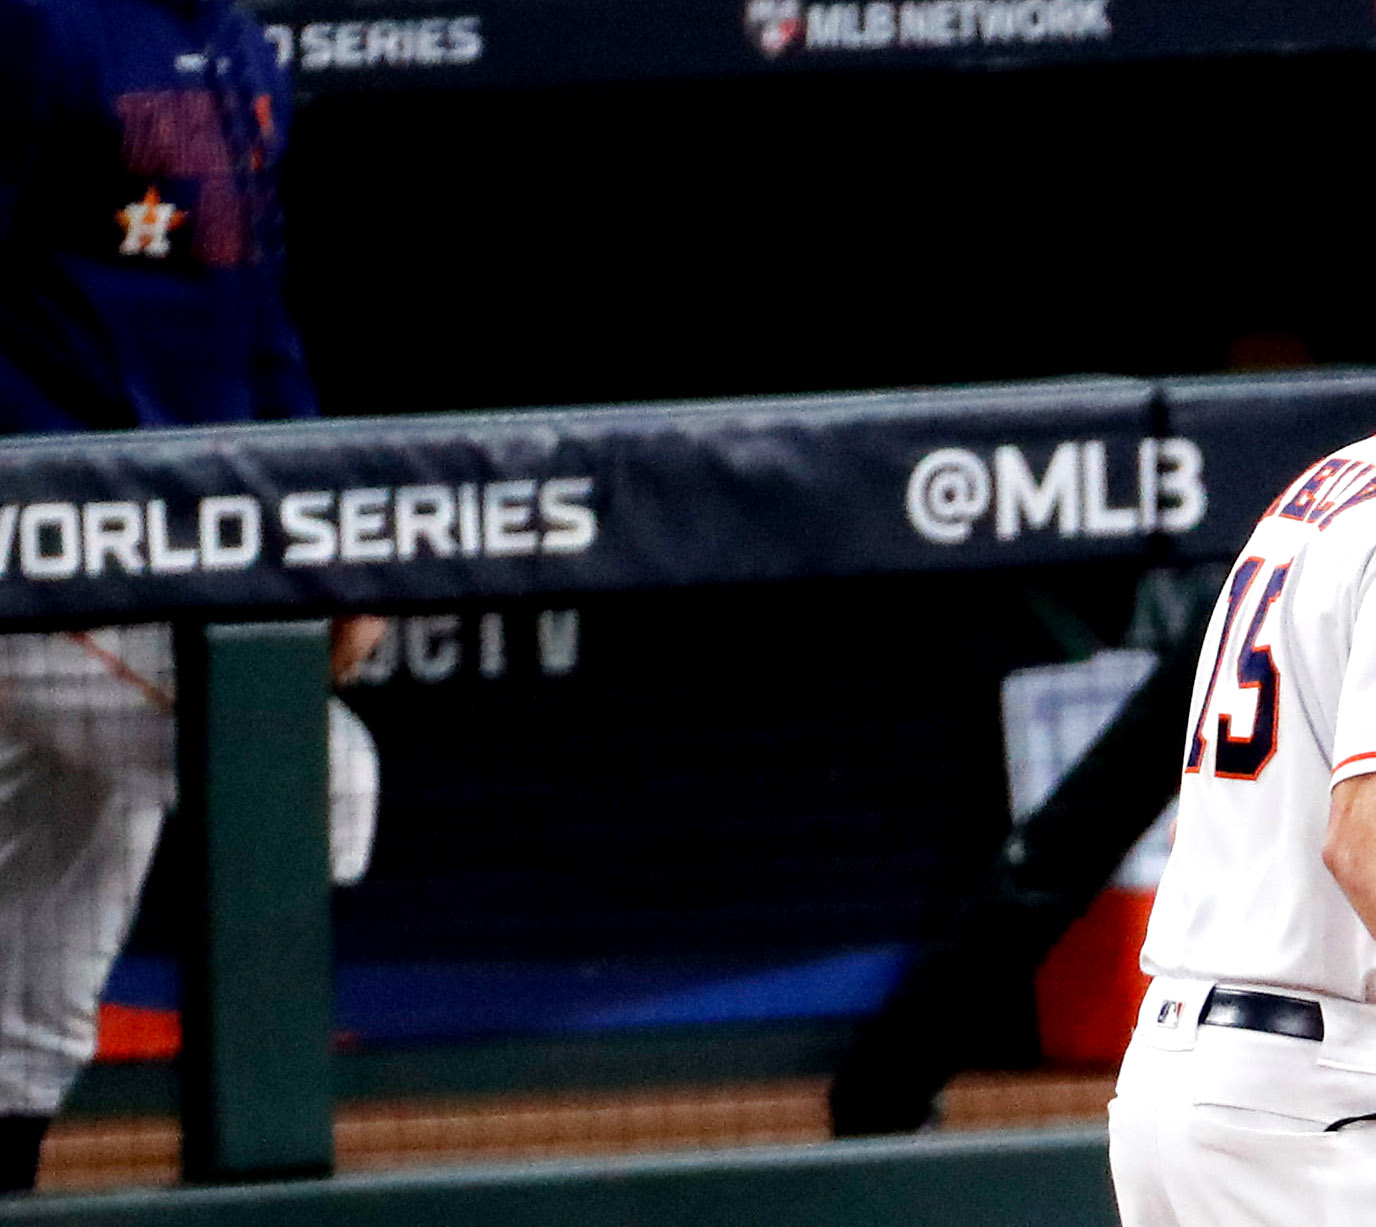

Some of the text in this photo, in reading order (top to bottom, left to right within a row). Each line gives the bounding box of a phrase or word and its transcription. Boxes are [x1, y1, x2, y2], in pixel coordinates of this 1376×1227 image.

[301, 16, 484, 70] SERIES
[805, 0, 1112, 50] MLB NETWORK
[0, 478, 598, 580] ORLD SERIES
[906, 437, 1208, 544] @MLB
[1185, 555, 1295, 782] 15
